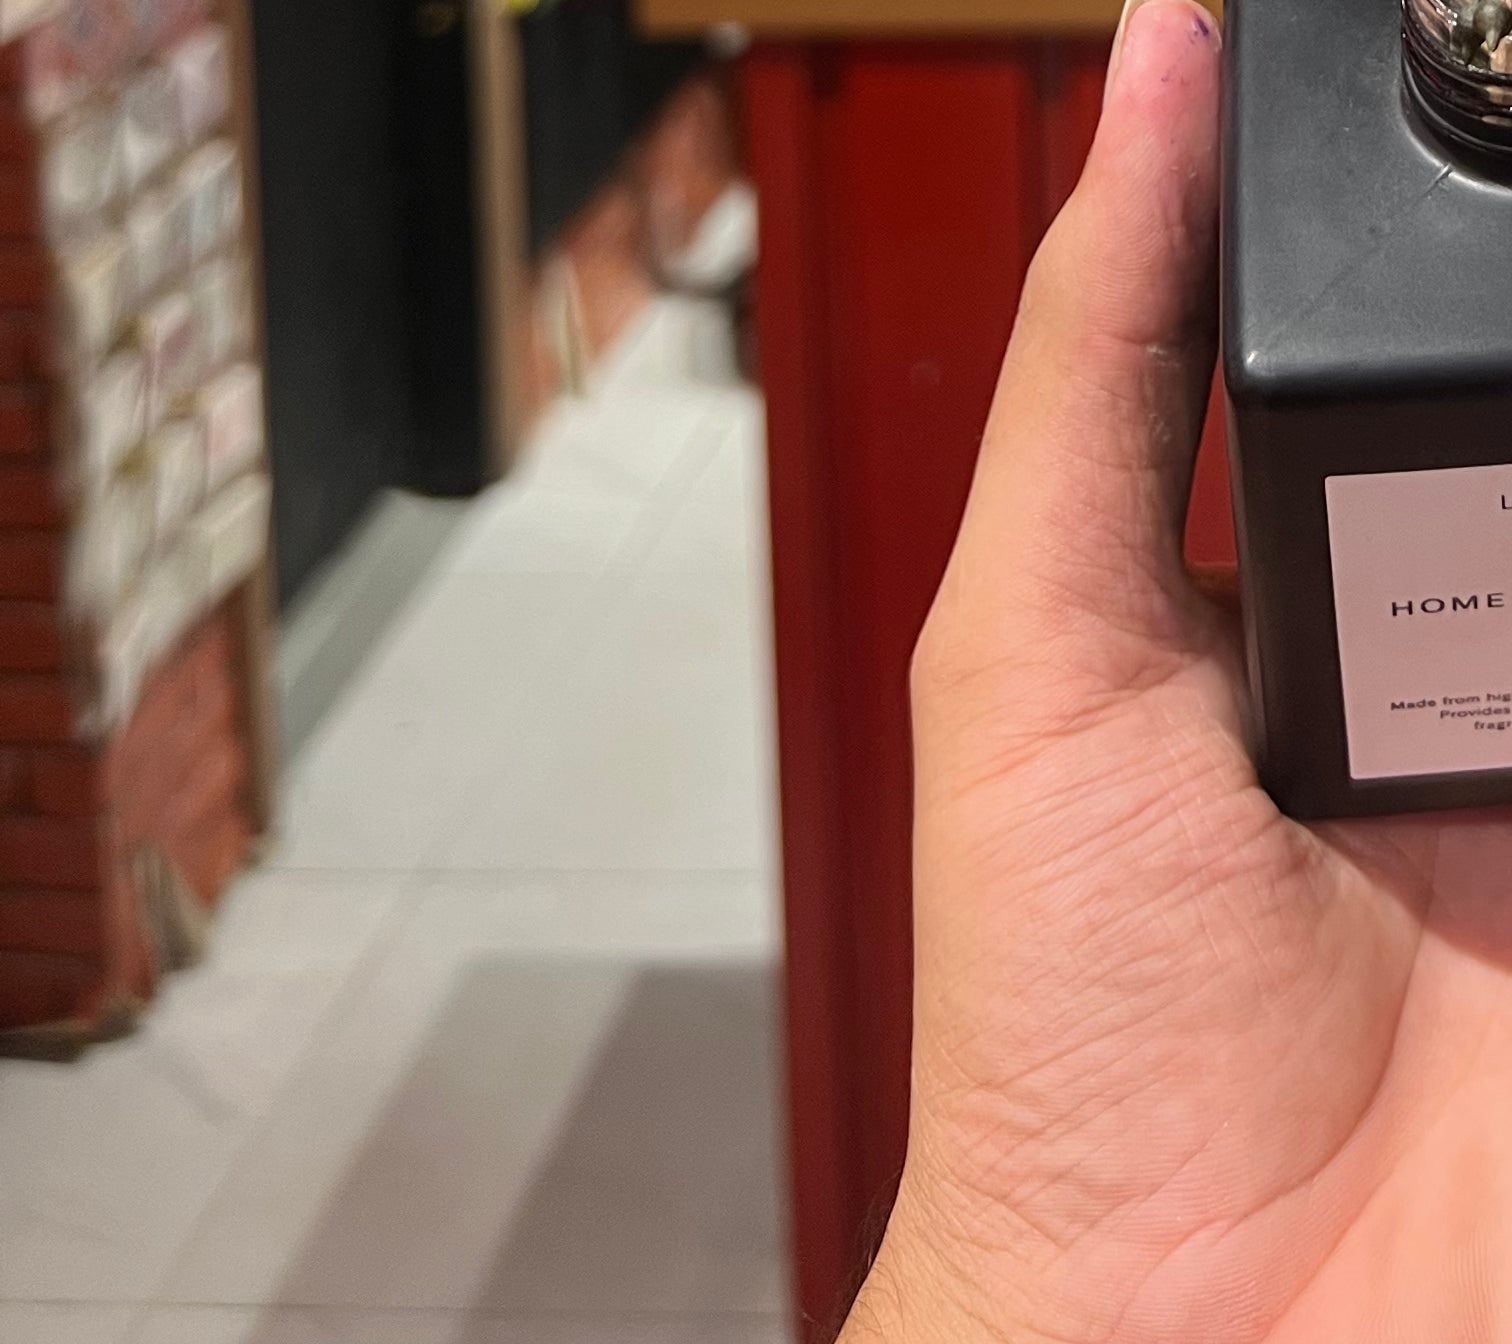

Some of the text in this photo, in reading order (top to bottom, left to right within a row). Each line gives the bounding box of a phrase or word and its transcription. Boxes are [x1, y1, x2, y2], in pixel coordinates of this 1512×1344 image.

[1391, 591, 1505, 617] HOME
[1390, 699, 1437, 711] Made
[1442, 696, 1481, 706] from
[1440, 706, 1511, 719] Provides
